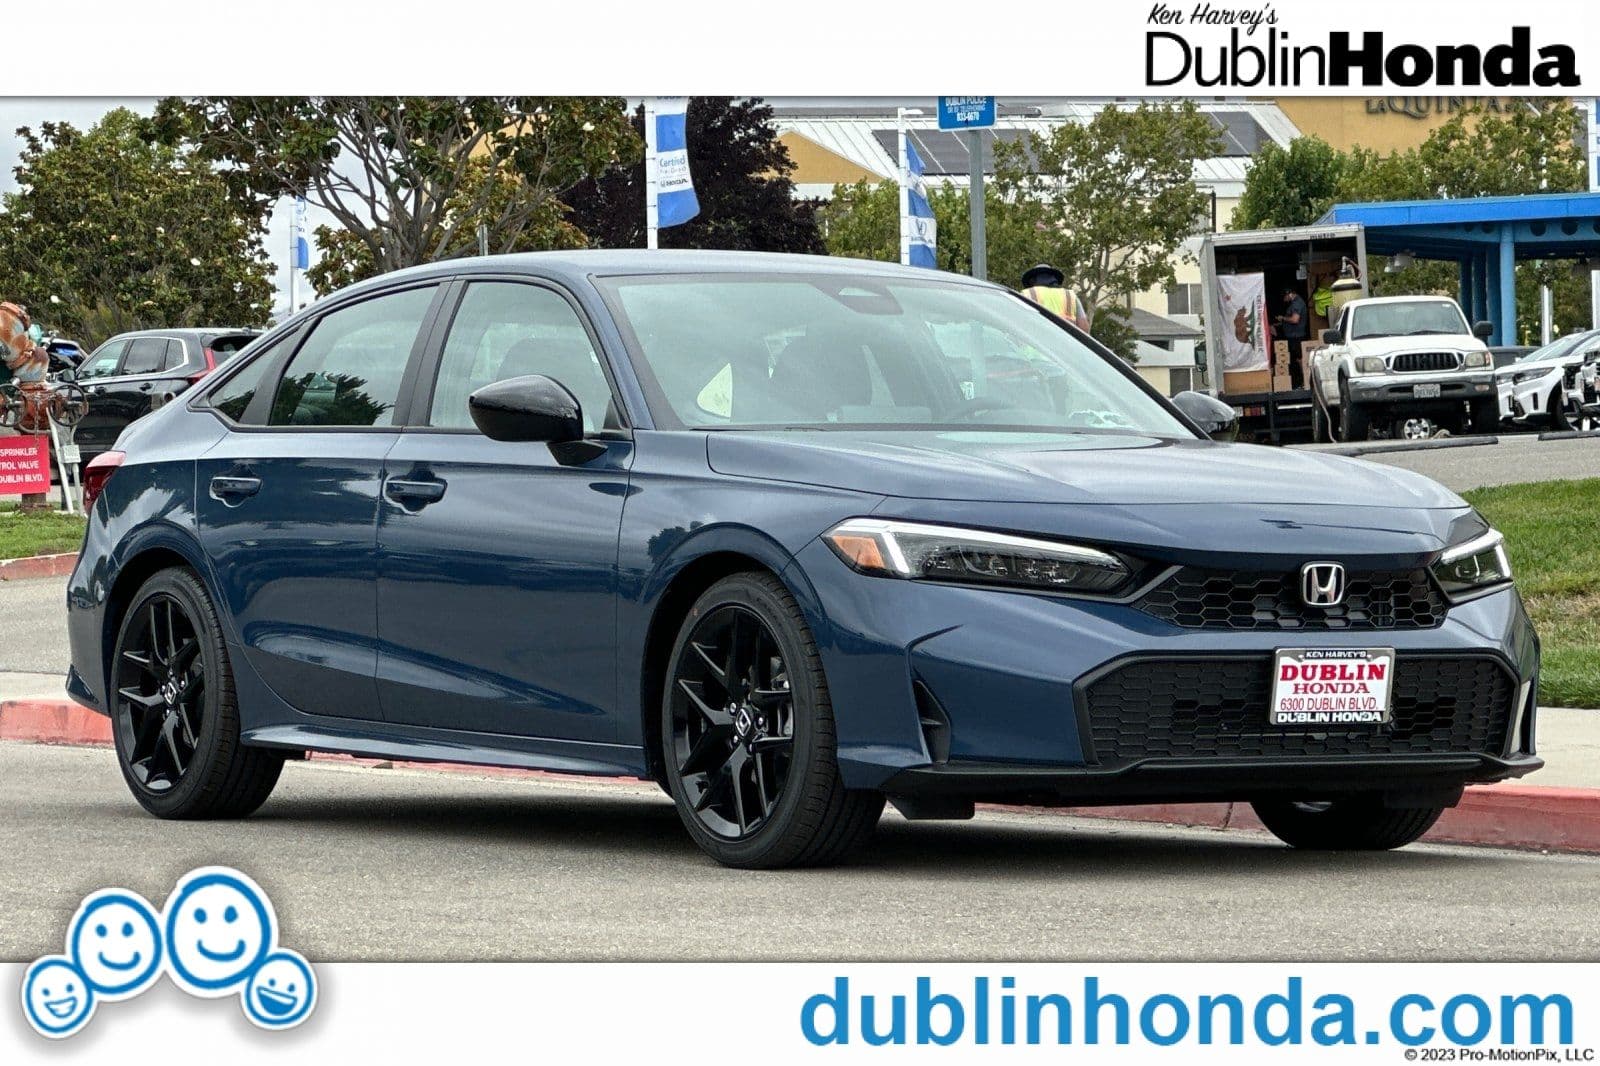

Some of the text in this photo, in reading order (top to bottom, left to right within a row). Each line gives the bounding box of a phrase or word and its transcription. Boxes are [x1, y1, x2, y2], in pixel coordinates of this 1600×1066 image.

[0, 447, 38, 457] SPRINKLER
[17, 460, 40, 470] VALVE
[1325, 650, 1367, 658] HARVEY'S
[1280, 664, 1386, 681] DUBLIN
[1293, 683, 1370, 694] HONDA
[1280, 697, 1378, 711] 6300 DUBLIN BLVD.
[1277, 711, 1381, 723] DUBLIN HONDA
